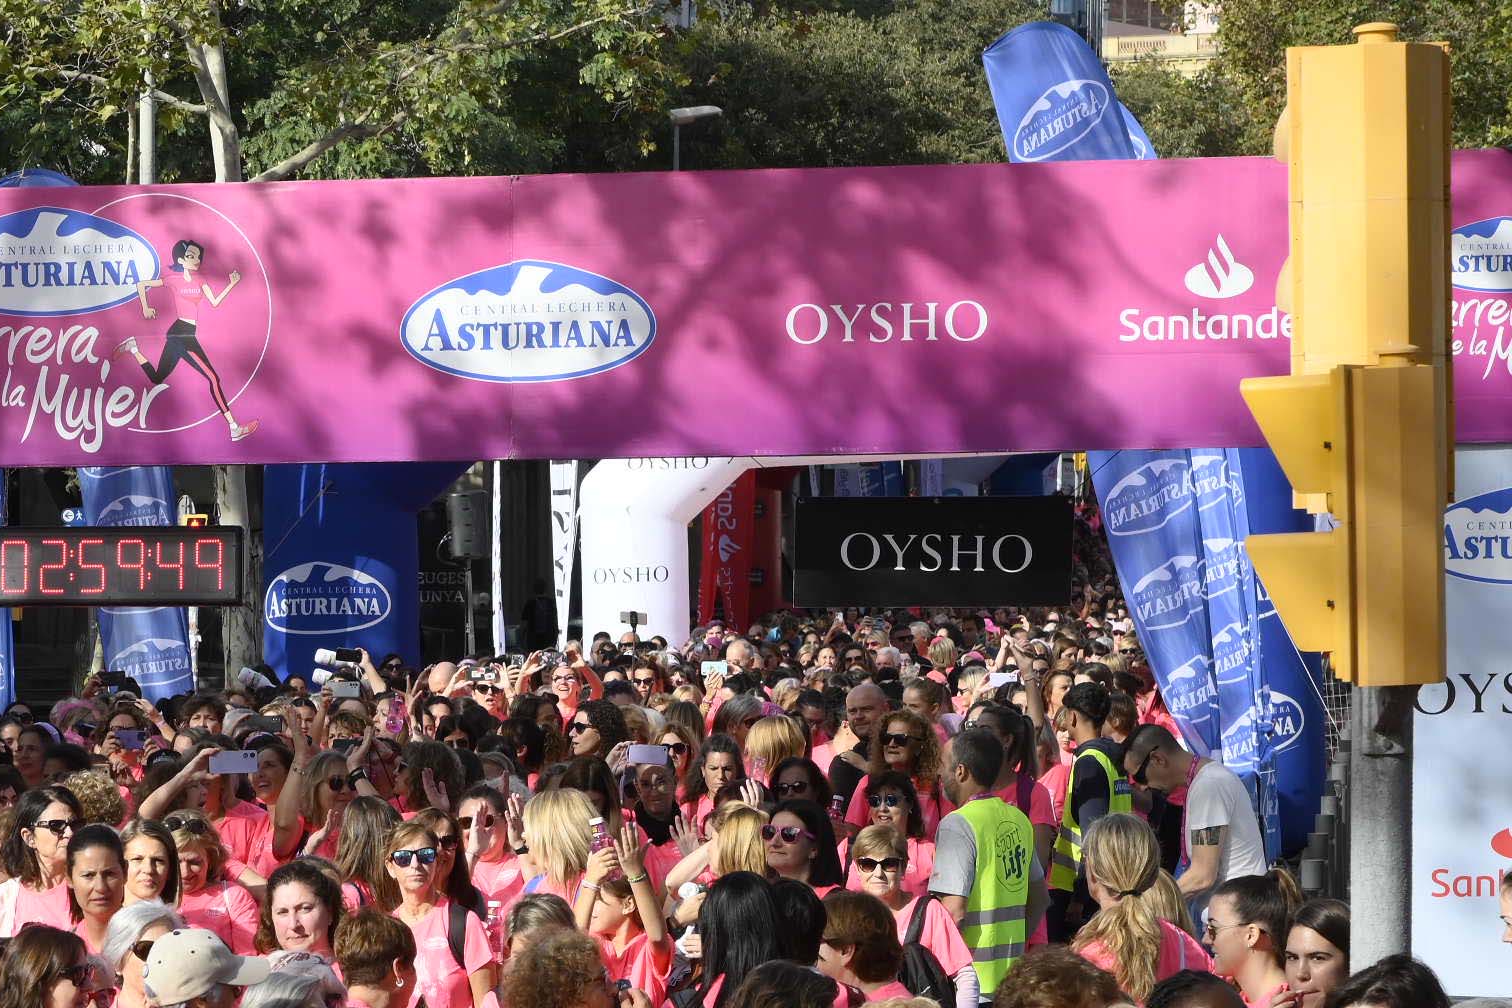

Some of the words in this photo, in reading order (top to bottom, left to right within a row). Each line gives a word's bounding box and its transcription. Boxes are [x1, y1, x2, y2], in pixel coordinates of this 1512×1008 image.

[63, 242, 135, 255] LECHERA
[460, 303, 537, 317] CENTRAL
[547, 300, 628, 315] LECHERA
[786, 300, 988, 344] OYSHO
[1119, 307, 1293, 342] Santande
[421, 308, 635, 353] ASTURIANA
[1470, 328, 1487, 355] la
[1, 367, 26, 408] la
[21, 360, 170, 454] Mujer
[0, 539, 224, 593] 02:59:49
[840, 531, 1033, 573] OYSHO
[593, 565, 669, 584] OYSHO
[269, 590, 380, 620] ASTURIANA
[420, 590, 465, 602] UNYA
